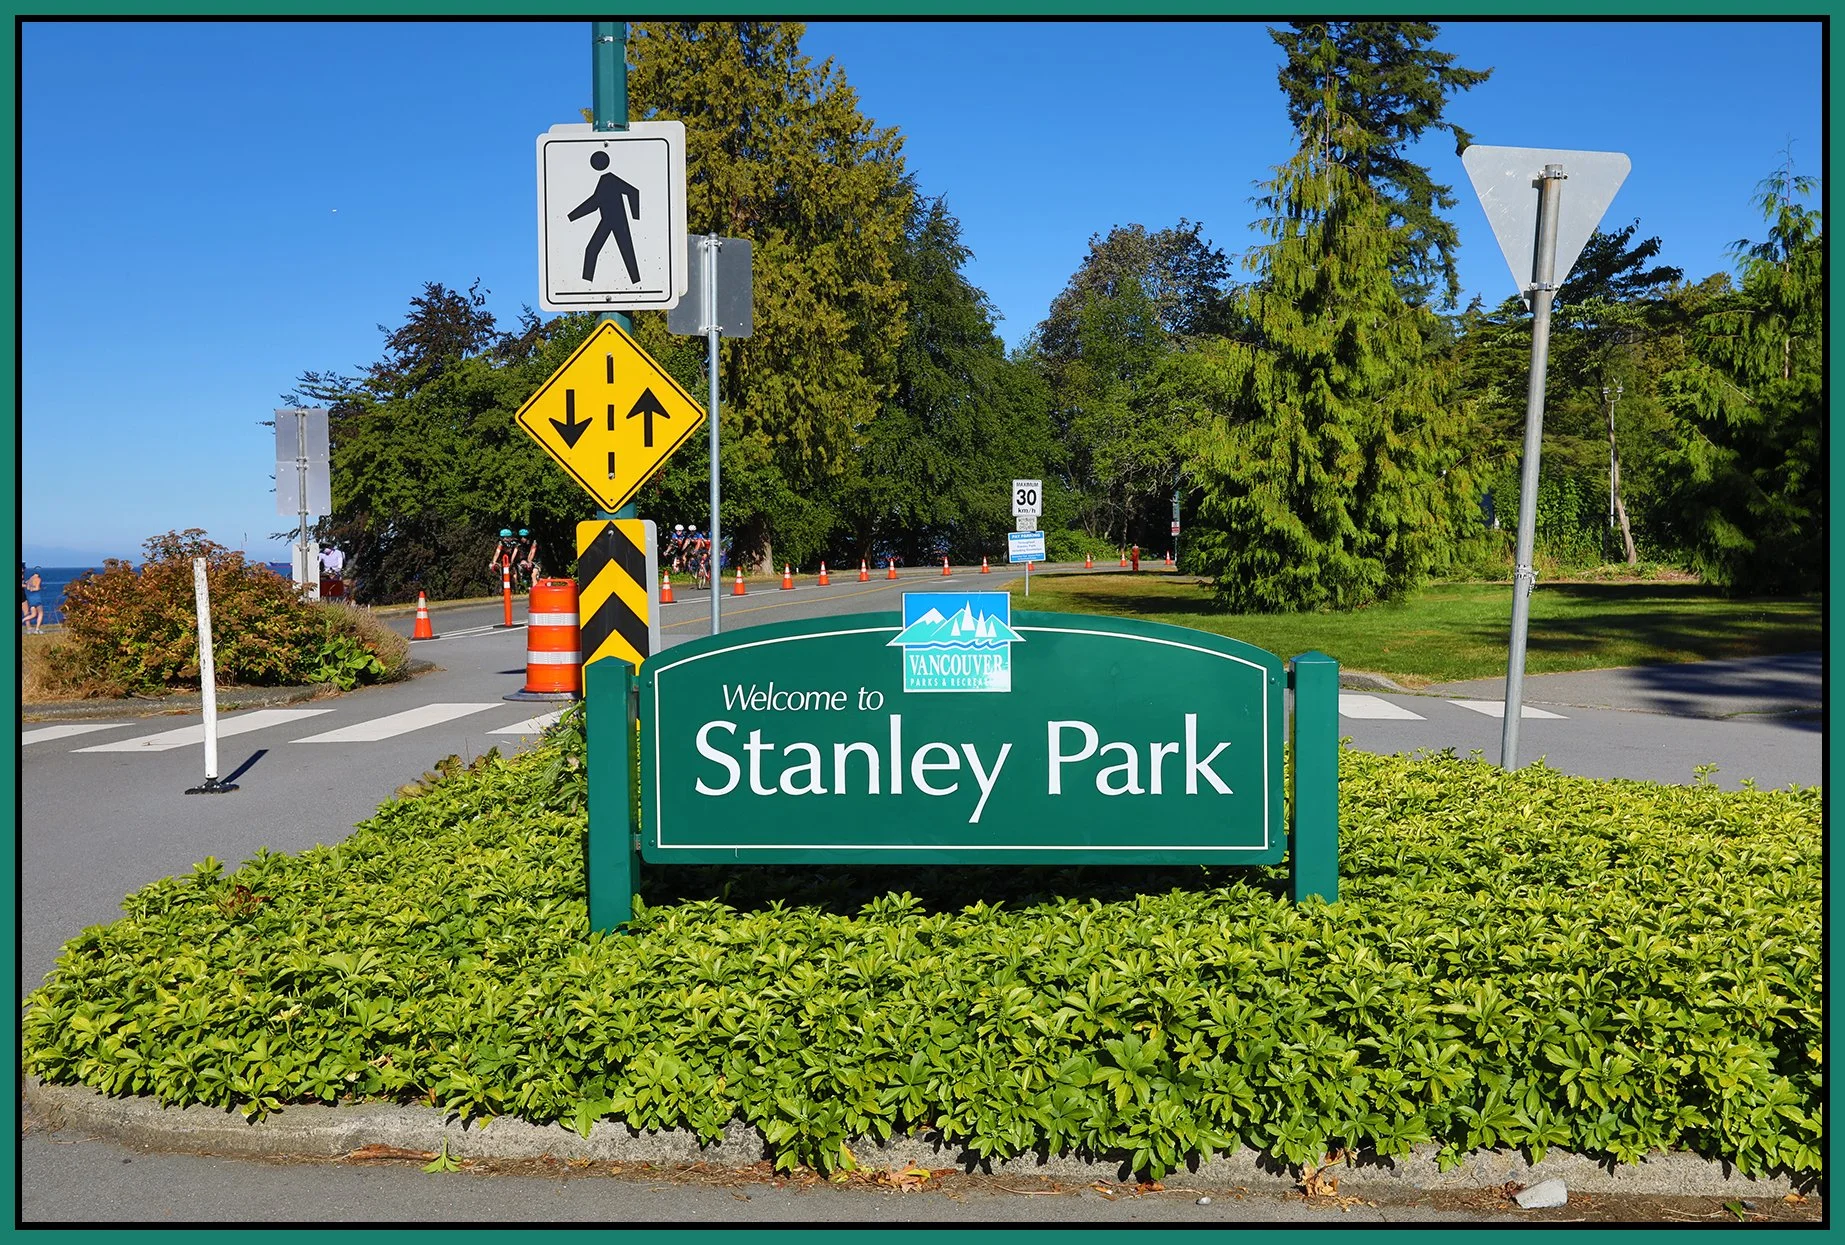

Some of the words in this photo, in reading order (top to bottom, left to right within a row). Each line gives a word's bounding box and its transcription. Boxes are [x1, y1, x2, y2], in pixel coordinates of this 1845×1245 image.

[1016, 489, 1037, 505] 30
[909, 654, 1003, 676] VANCOUVER
[910, 678, 938, 687] PARKS
[941, 678, 947, 687] &
[950, 678, 991, 688] RECREA
[722, 683, 847, 711] Welcome
[857, 686, 884, 711] to
[695, 714, 1012, 823] Stanley
[1047, 713, 1234, 796] Park
